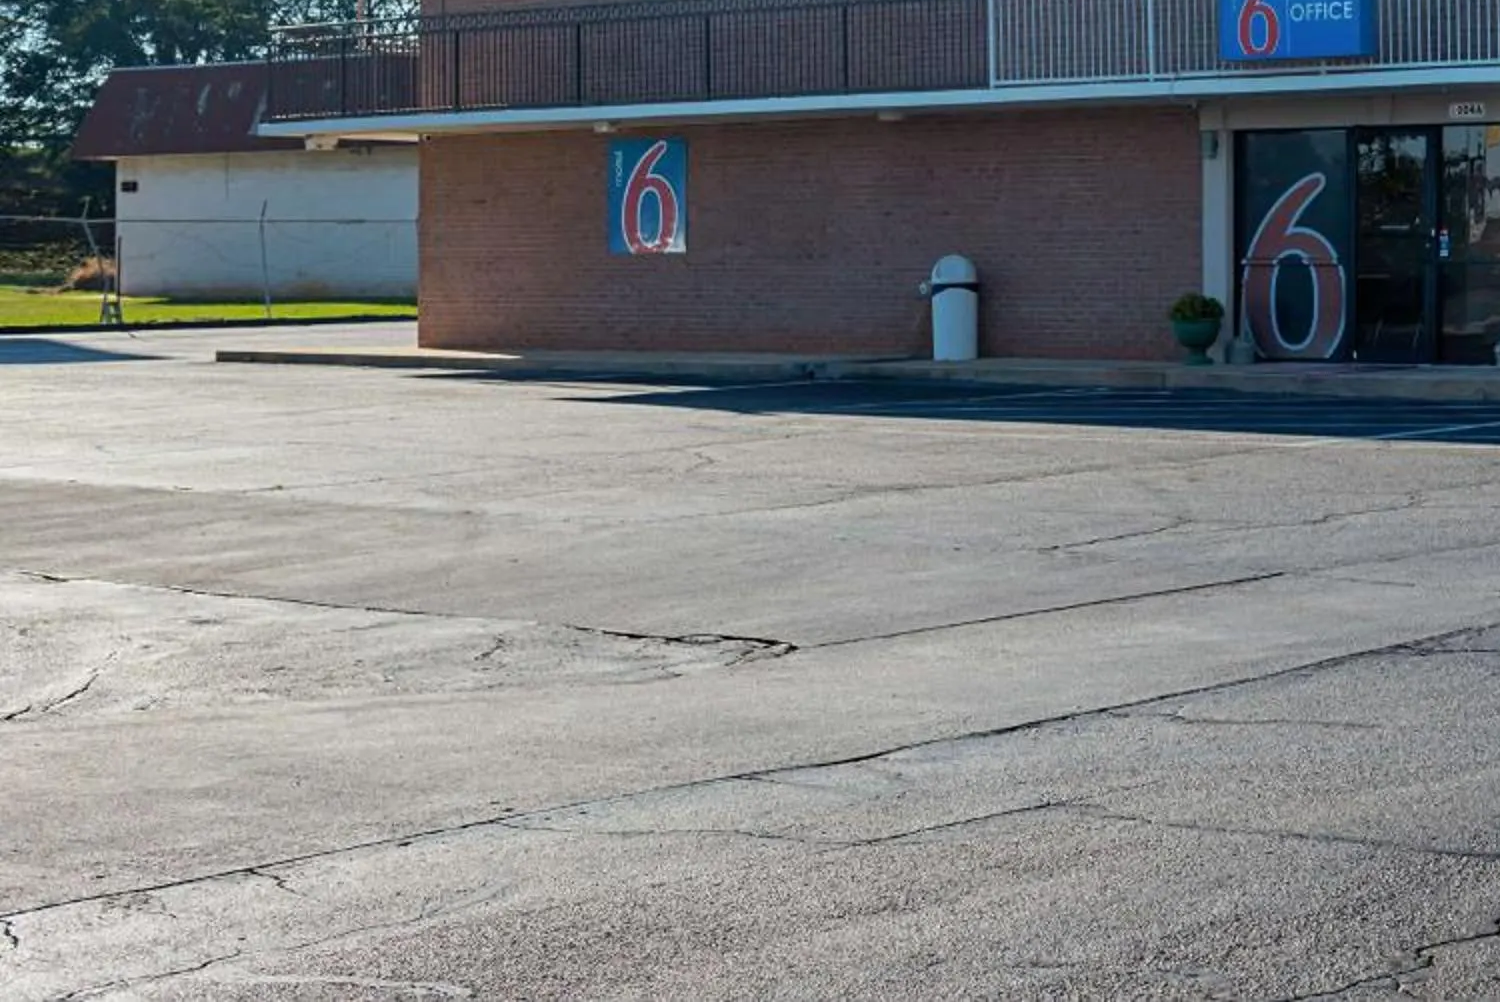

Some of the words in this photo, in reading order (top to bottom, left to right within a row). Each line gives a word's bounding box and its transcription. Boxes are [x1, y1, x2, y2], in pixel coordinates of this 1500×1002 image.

[1290, 1, 1353, 22] OFFICE
[622, 140, 678, 255] 6
[1243, 172, 1347, 359] 6
